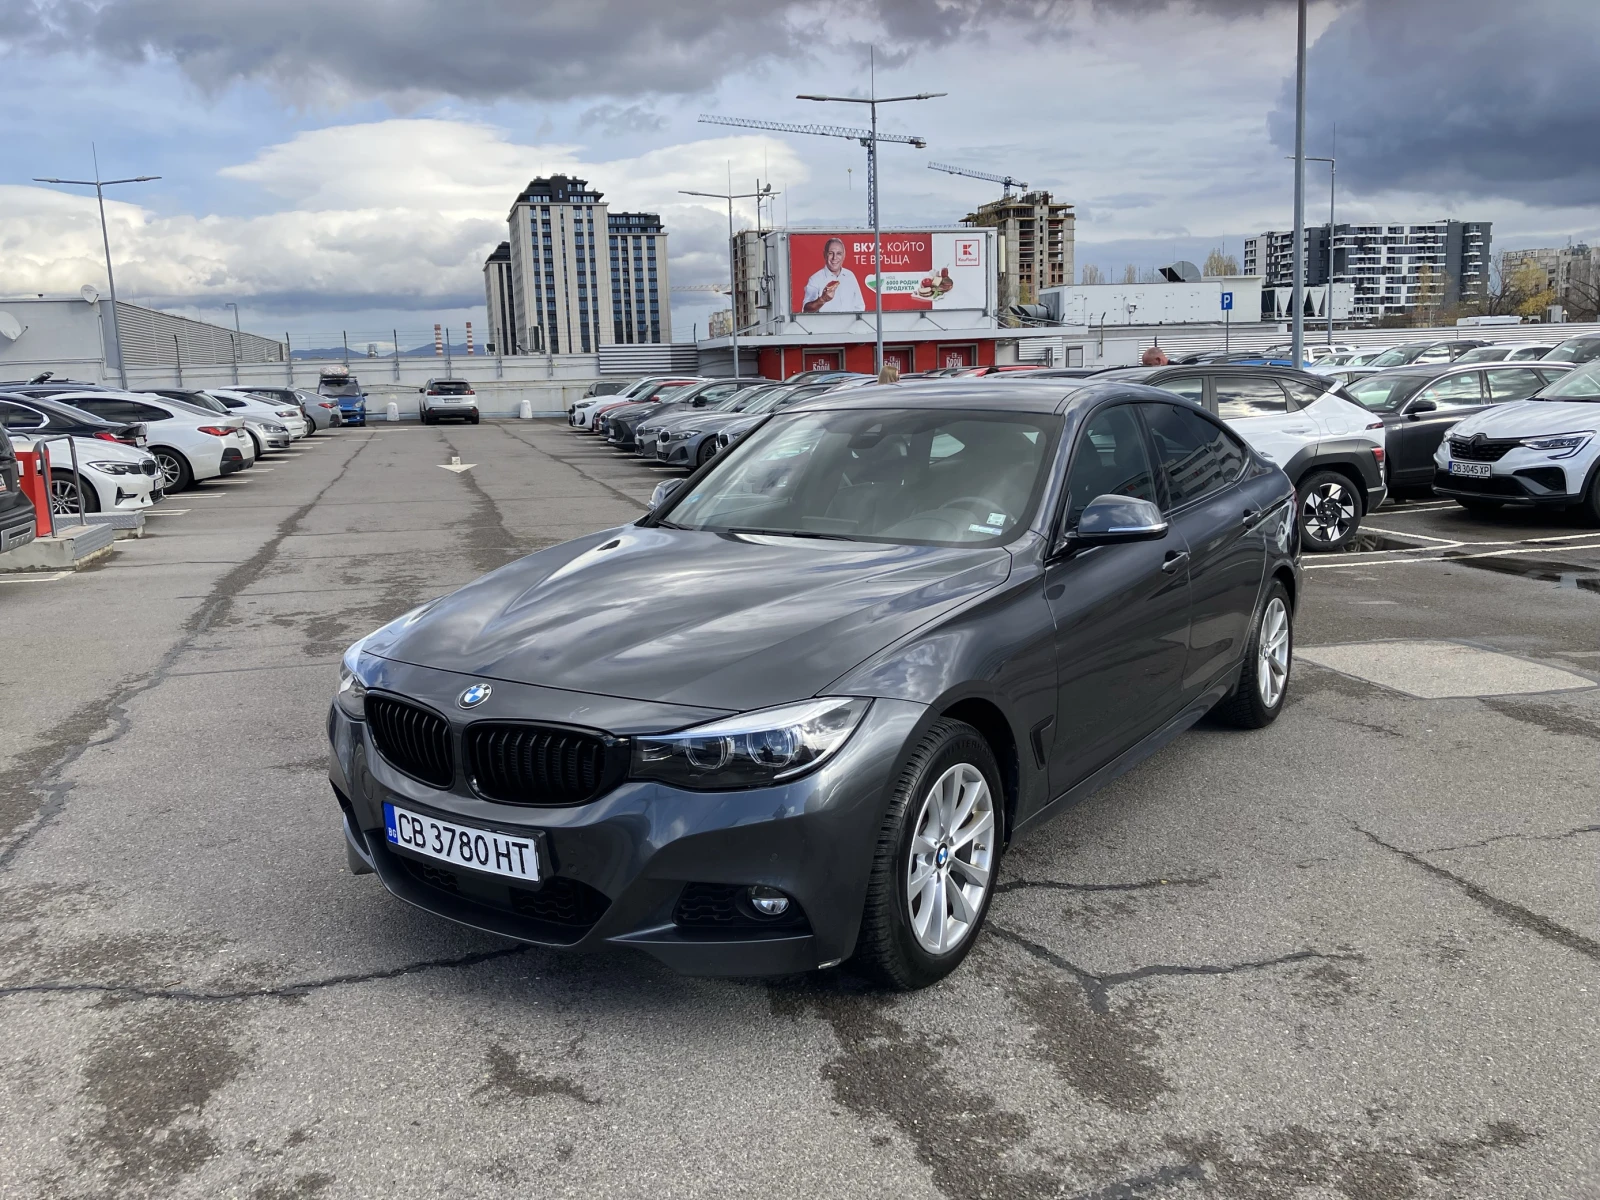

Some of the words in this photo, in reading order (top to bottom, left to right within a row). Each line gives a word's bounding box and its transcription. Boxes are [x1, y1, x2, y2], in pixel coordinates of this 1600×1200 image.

[887, 240, 925, 252] КОЙТО
[854, 255, 867, 265] ТЕ
[1224, 295, 1231, 308] P
[1453, 464, 1461, 473] CB
[1462, 465, 1478, 474] 3045
[1480, 466, 1489, 475] XP
[388, 827, 397, 838] BG
[398, 813, 427, 849] CB
[430, 823, 490, 866] 3780
[493, 838, 529, 875] HT
